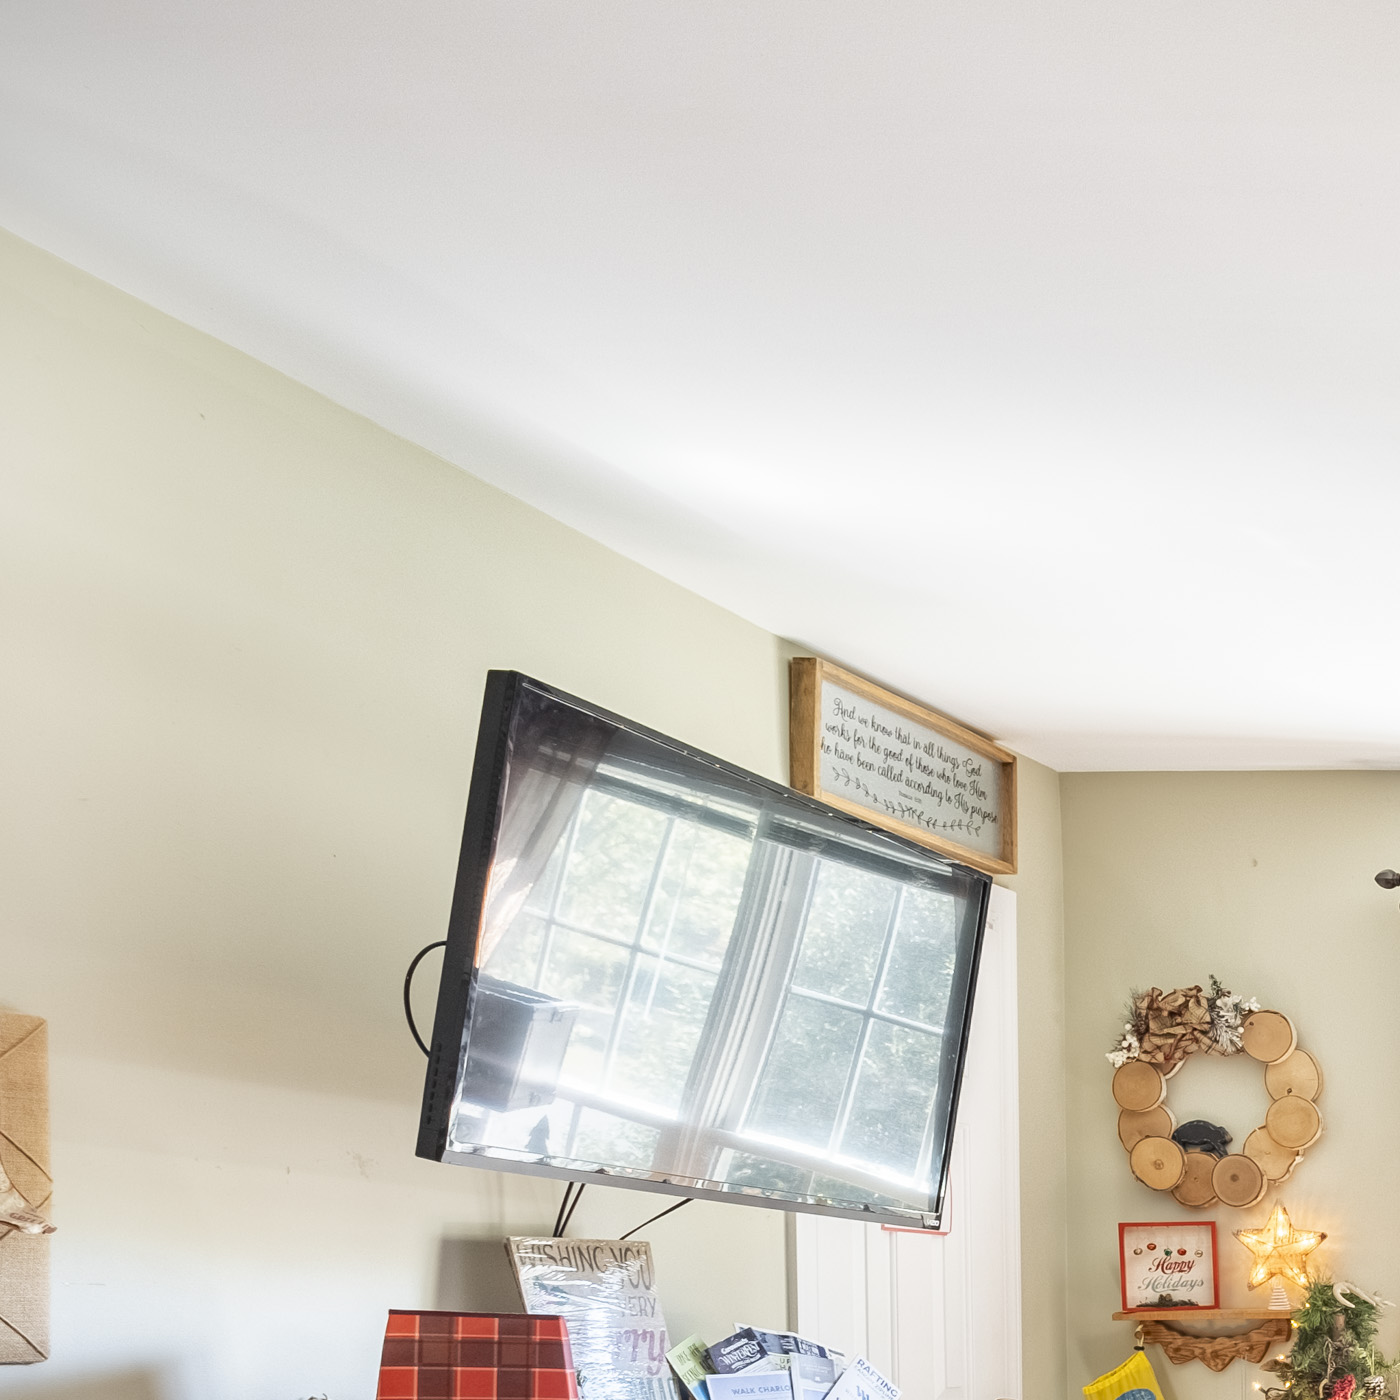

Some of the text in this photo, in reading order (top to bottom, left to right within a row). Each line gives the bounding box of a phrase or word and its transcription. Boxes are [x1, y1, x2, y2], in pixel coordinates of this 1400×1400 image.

[833, 698, 981, 777] And we know that in all things God
[825, 723, 987, 801] works for the good of those who love Him
[835, 742, 854, 764] have
[857, 752, 876, 771] been
[878, 765, 903, 783] called
[905, 776, 943, 807] according
[945, 789, 953, 804] to
[954, 793, 970, 815] His
[515, 1244, 607, 1273] WISHING
[1148, 1256, 1196, 1275] Happy
[1137, 1275, 1204, 1293] Holidays
[731, 1387, 755, 1396] WALK
[857, 1359, 898, 1398] RAFTING
